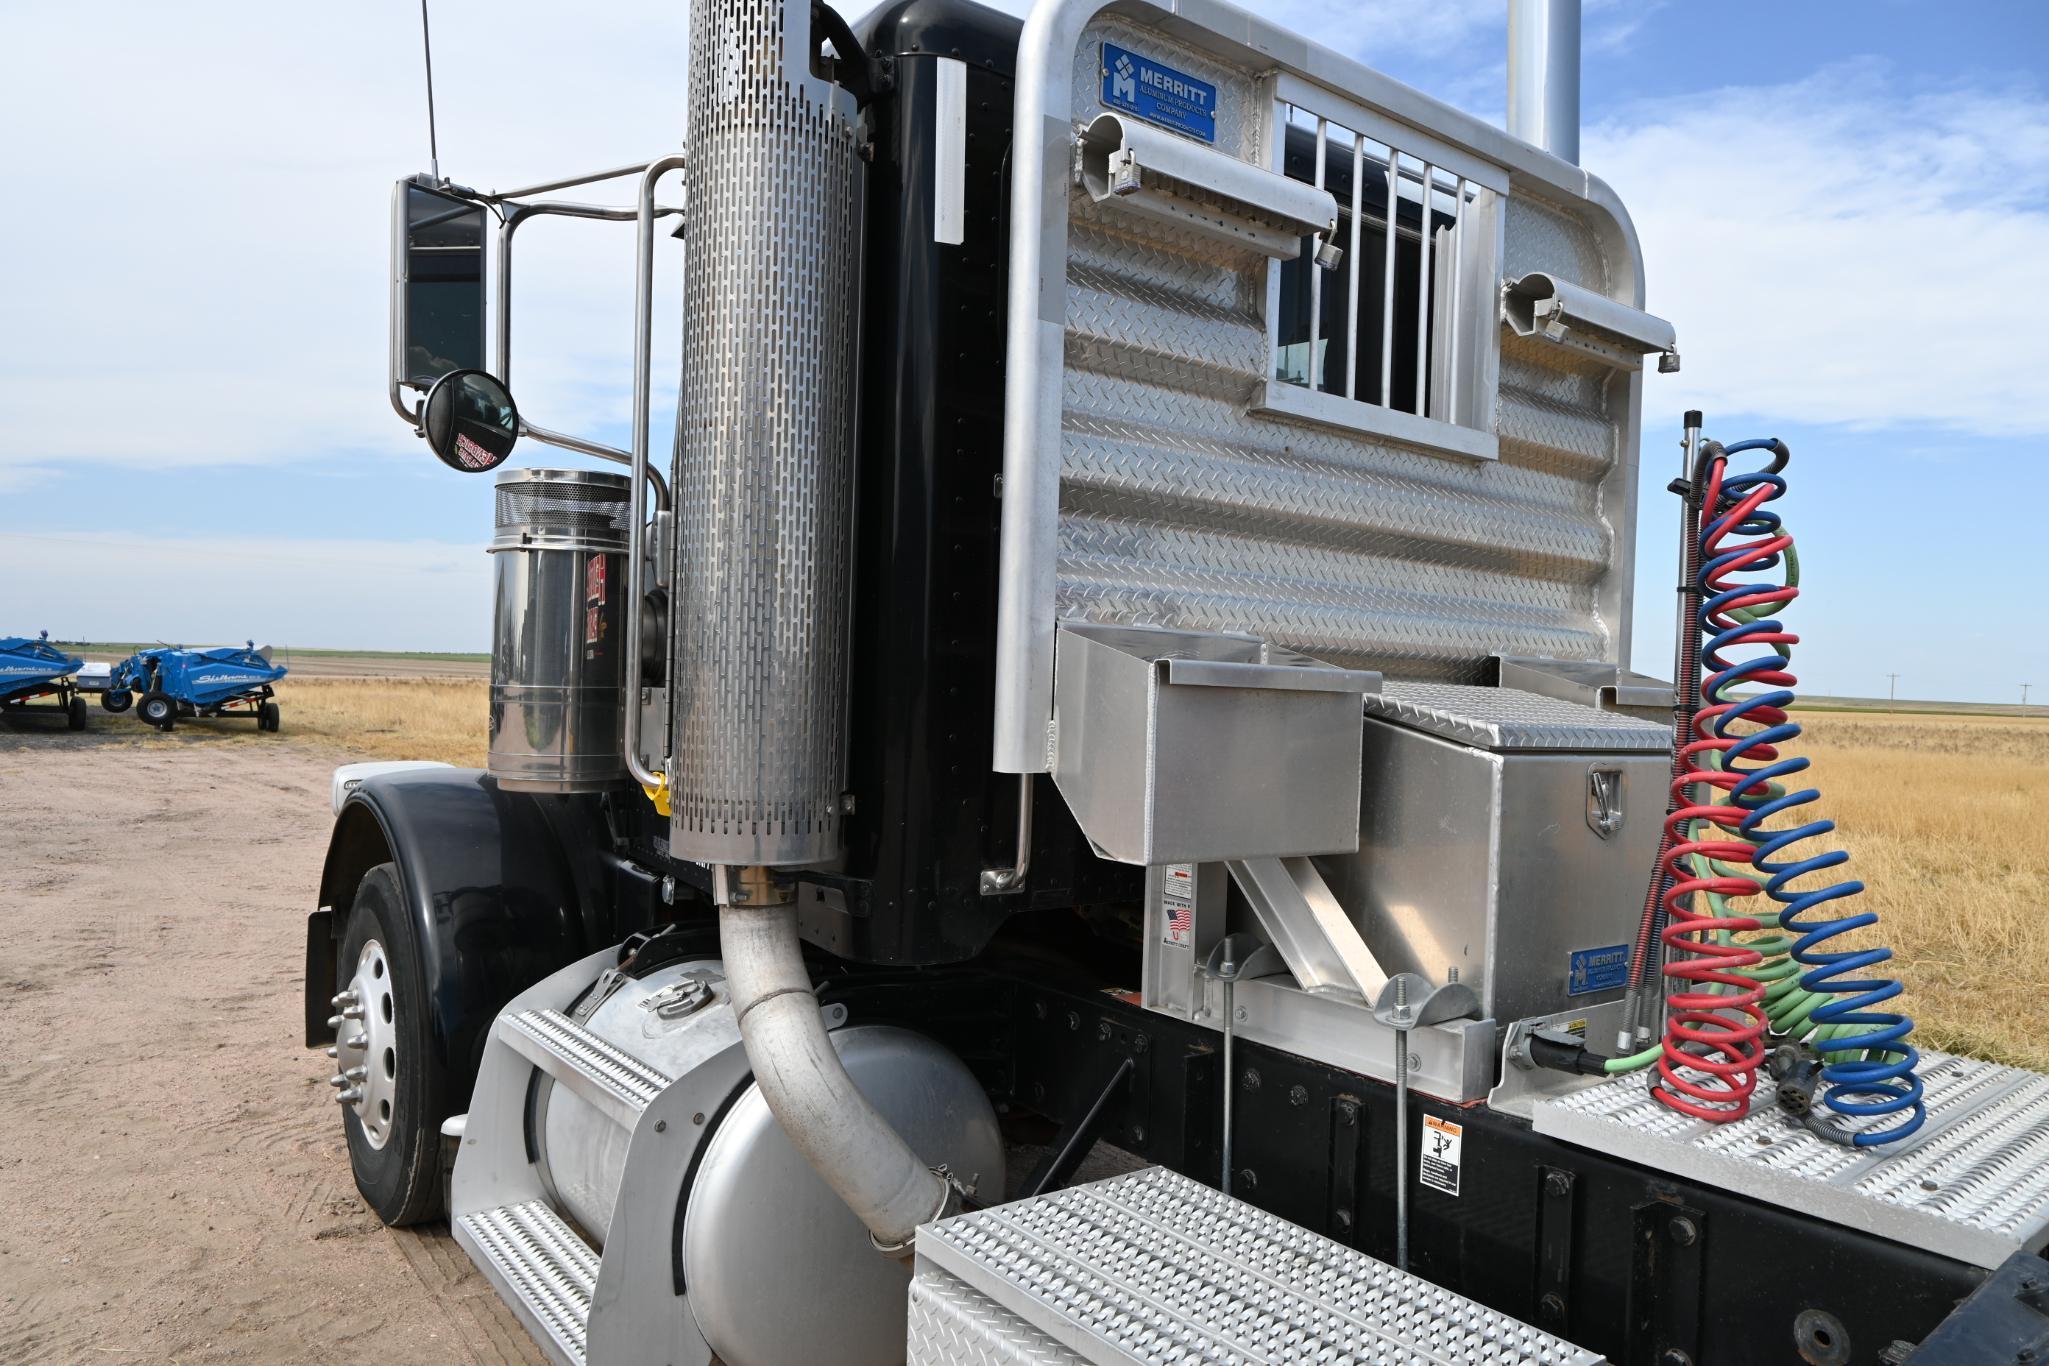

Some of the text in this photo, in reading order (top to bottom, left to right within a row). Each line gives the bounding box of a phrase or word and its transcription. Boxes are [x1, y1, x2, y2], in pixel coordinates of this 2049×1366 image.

[1140, 66, 1207, 105] MERRITT
[1140, 85, 1174, 105] ALUMINUM
[1174, 98, 1208, 118] PRODUCTS
[1156, 102, 1187, 120] COMPANY
